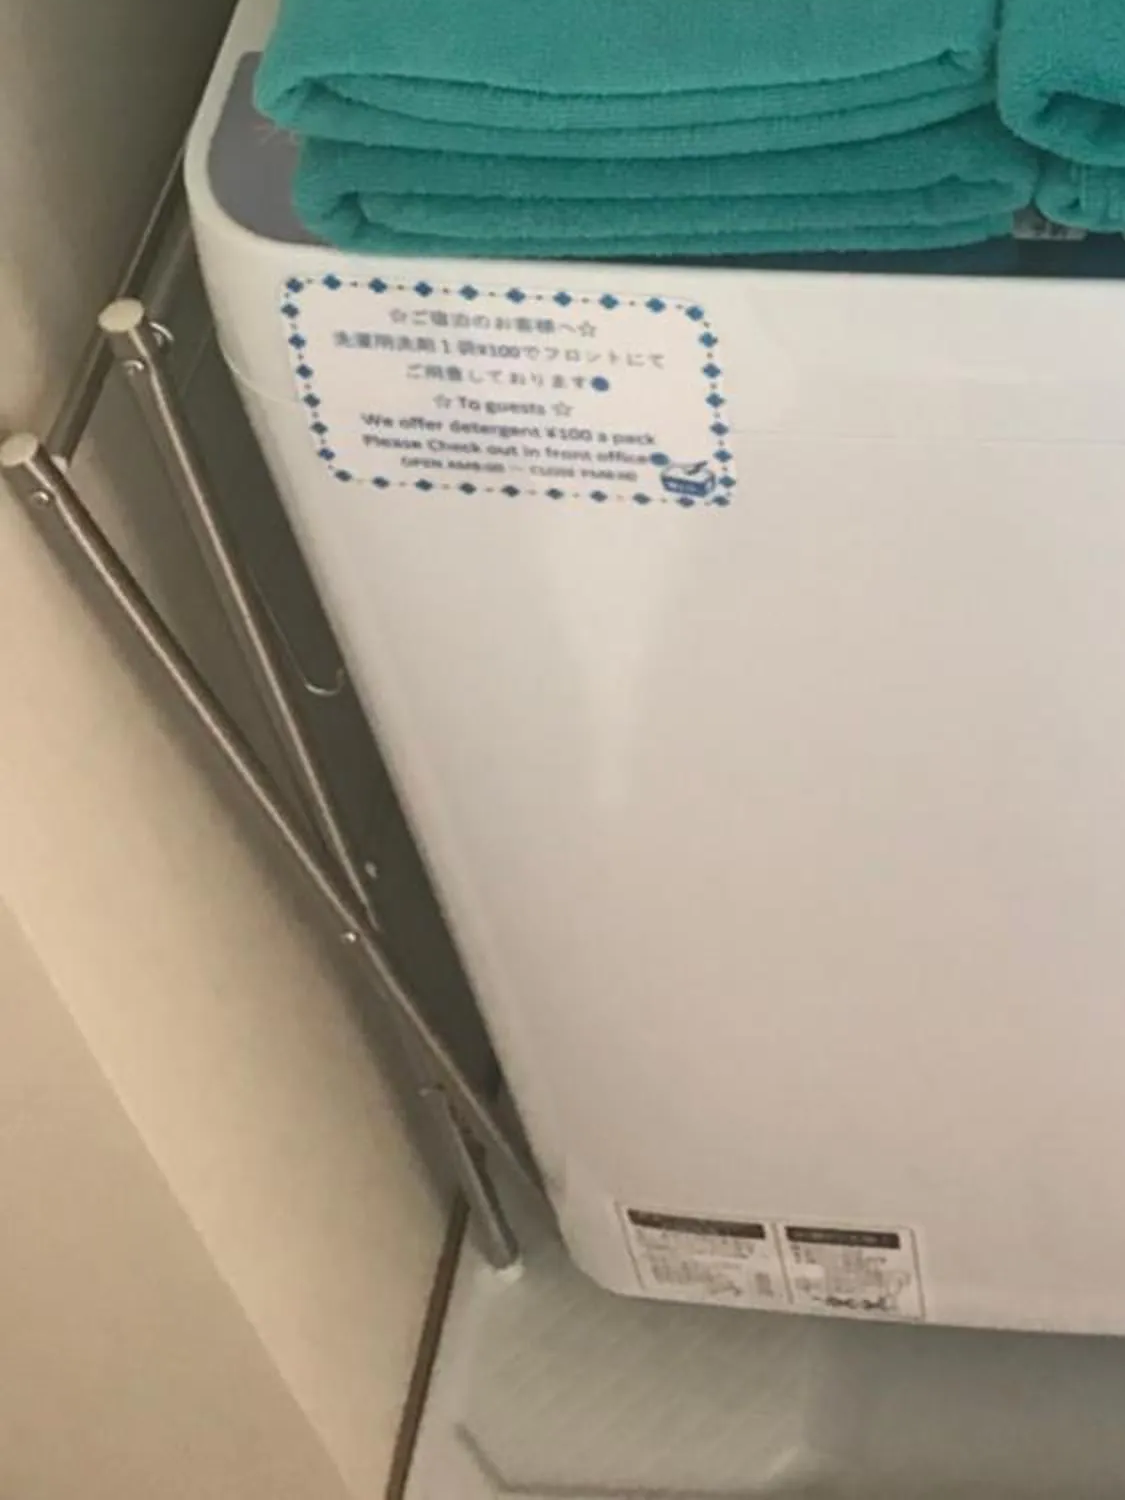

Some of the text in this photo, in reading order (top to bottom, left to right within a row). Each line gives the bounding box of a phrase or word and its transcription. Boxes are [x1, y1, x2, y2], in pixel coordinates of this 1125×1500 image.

[457, 395, 547, 416] To guests
[360, 412, 394, 428] We
[398, 416, 443, 432] offer
[449, 419, 541, 439] detergent
[612, 431, 657, 446] pack
[361, 433, 648, 466] Please Check out in front office
